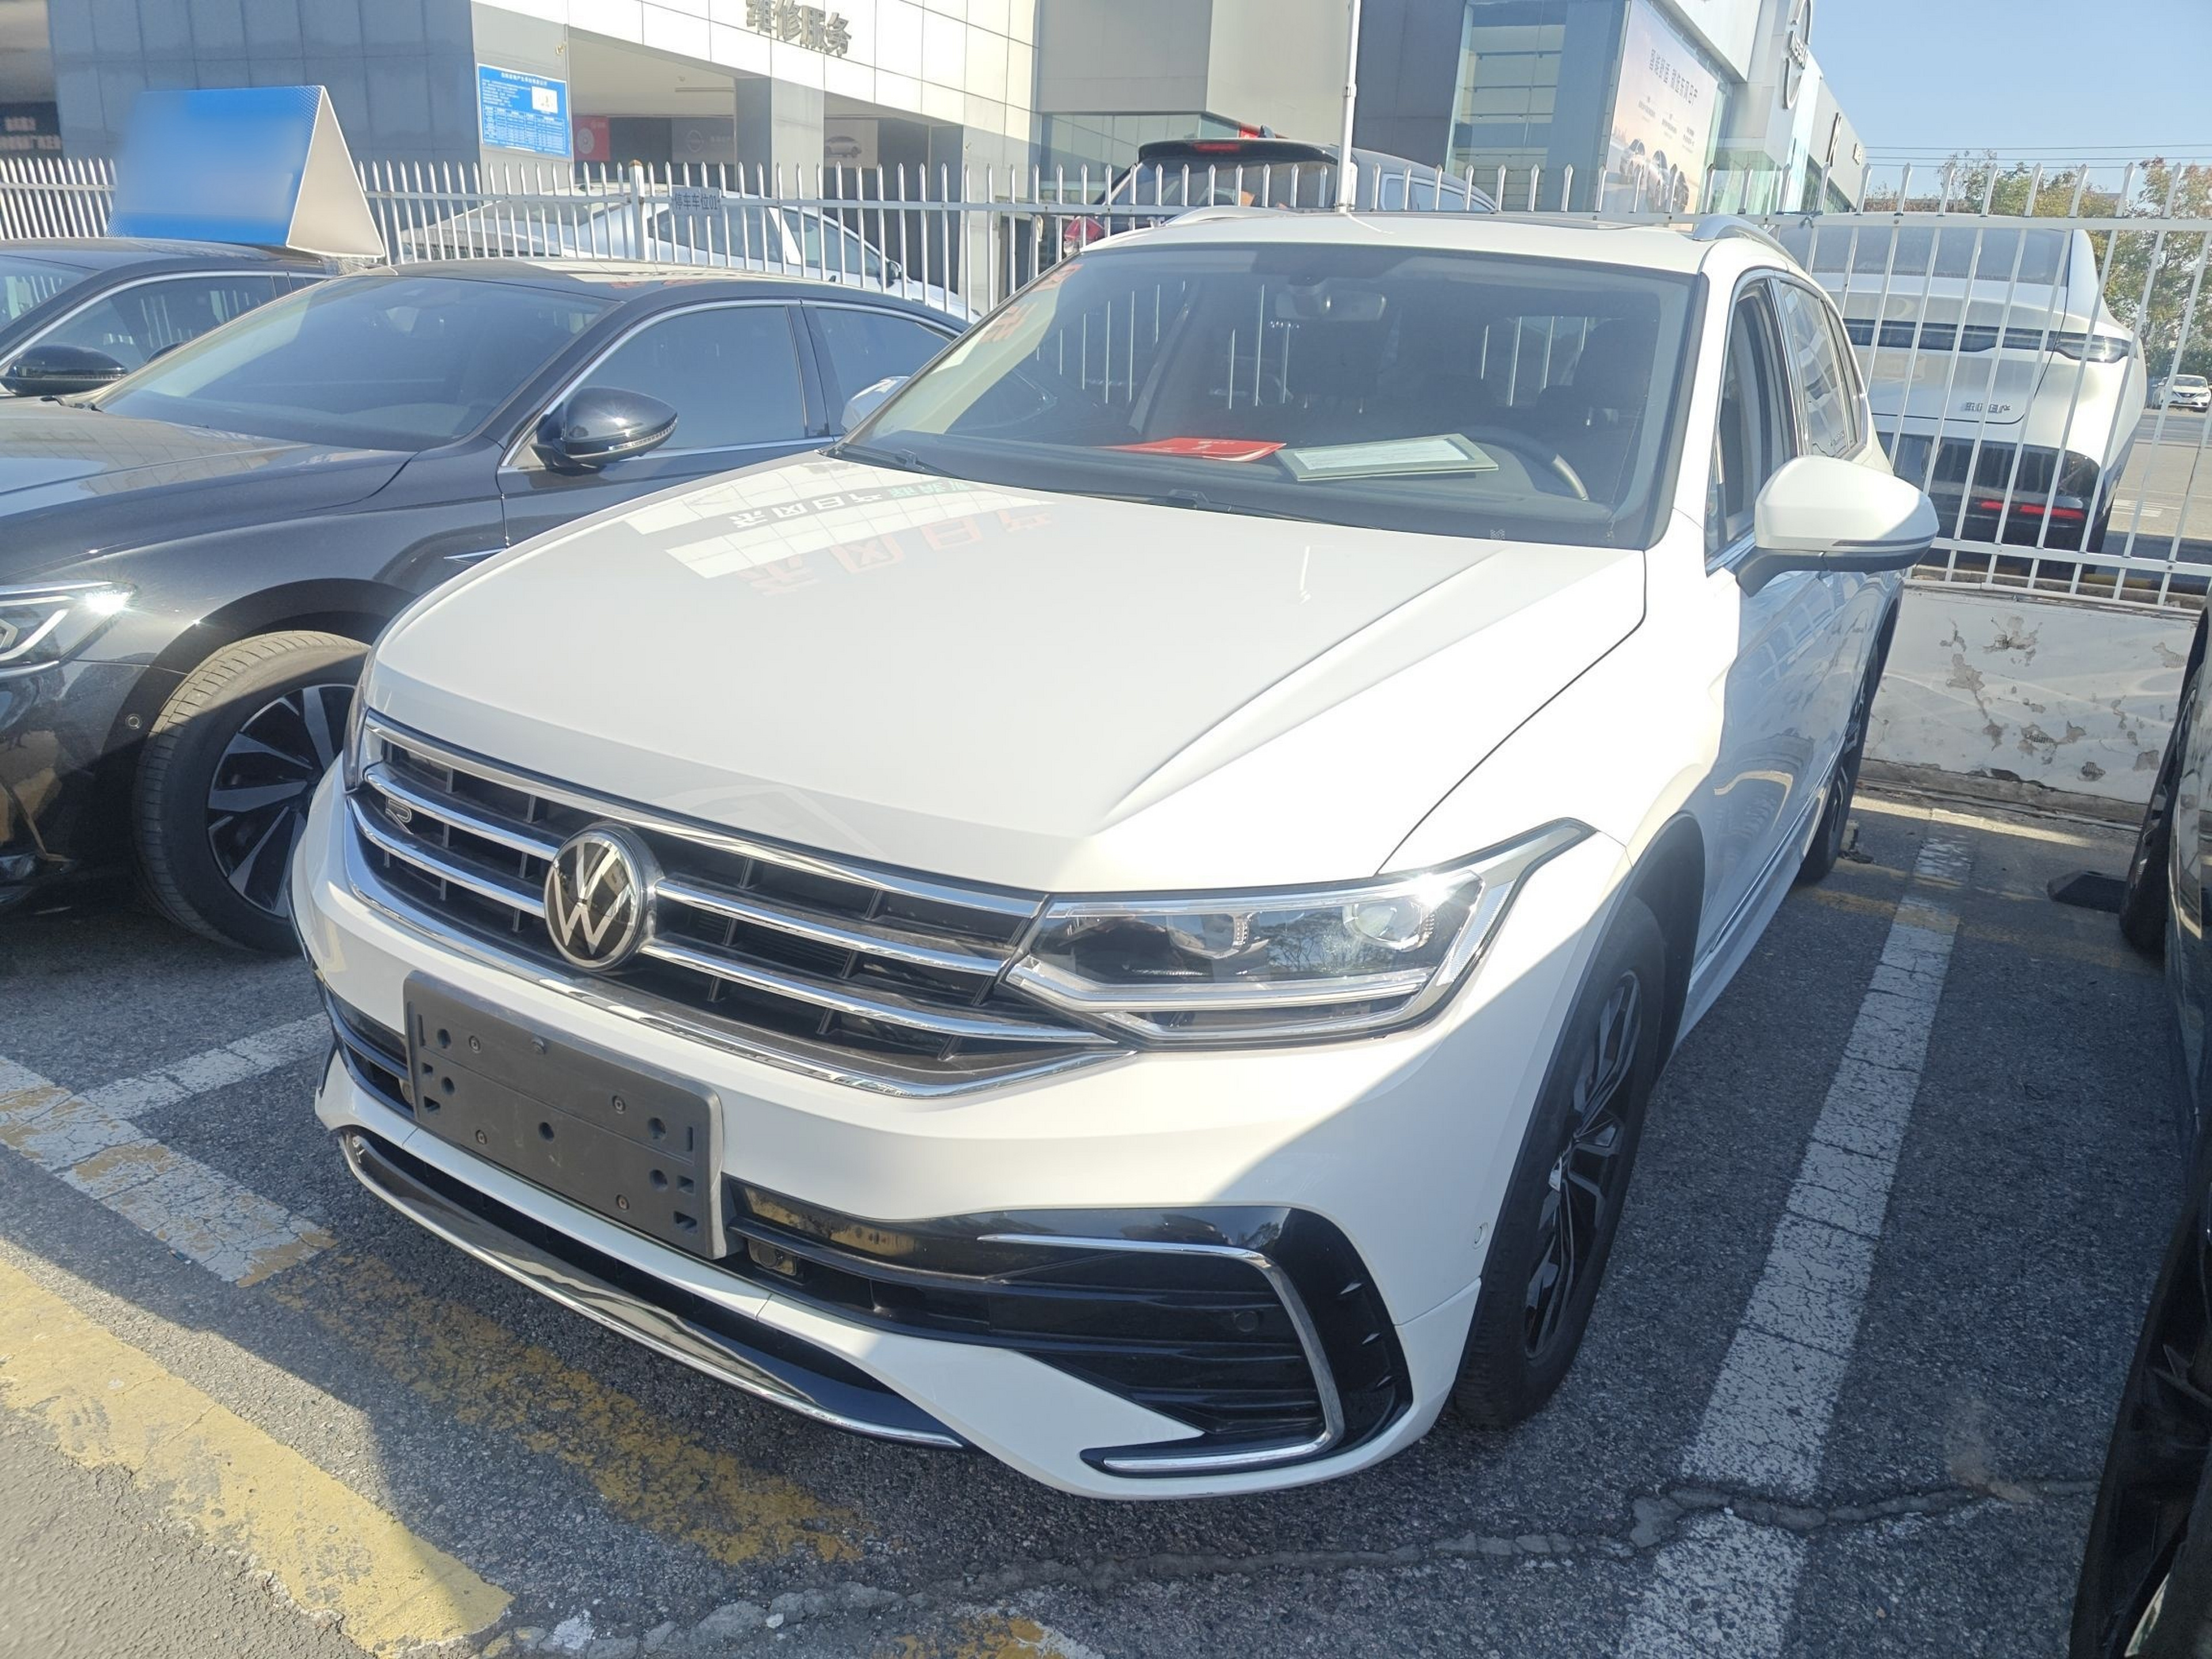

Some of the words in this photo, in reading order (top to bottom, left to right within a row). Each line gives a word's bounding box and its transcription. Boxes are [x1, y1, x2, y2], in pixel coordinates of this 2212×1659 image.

[746, 0, 852, 57] 维修服务
[675, 192, 718, 211] 停车车位01
[385, 798, 414, 835] R
